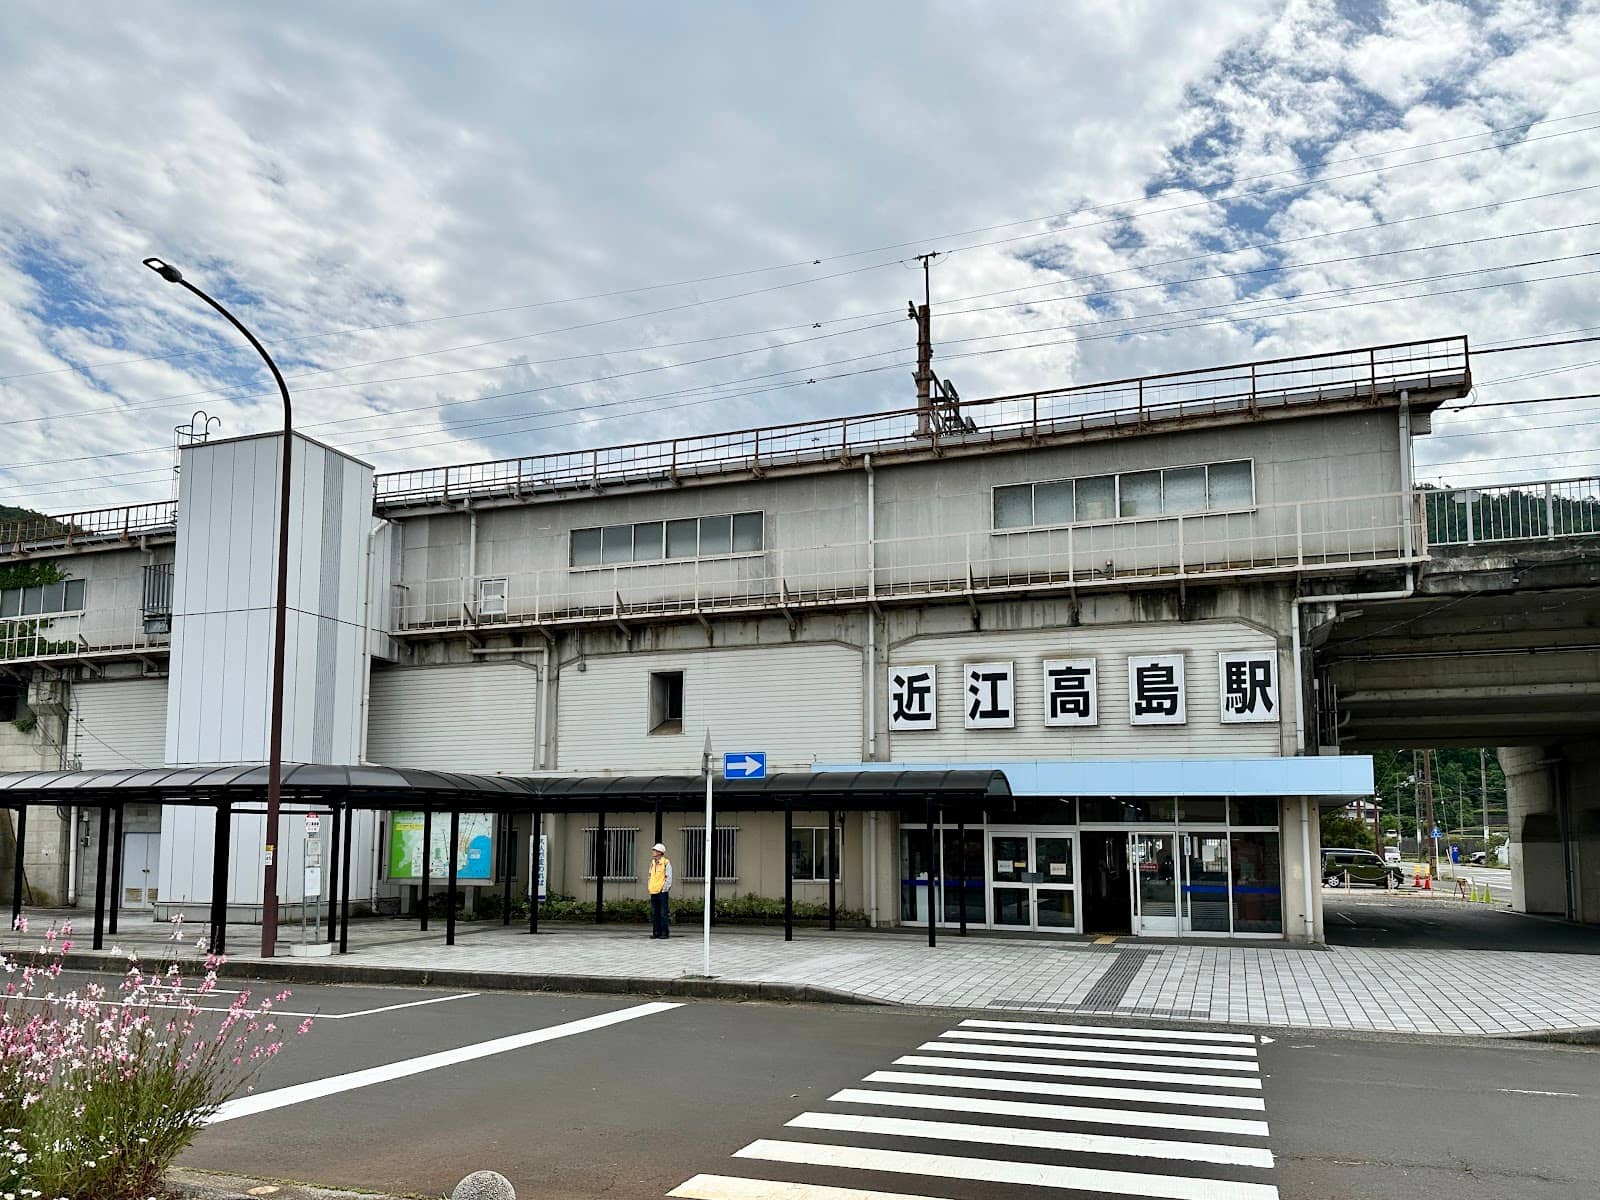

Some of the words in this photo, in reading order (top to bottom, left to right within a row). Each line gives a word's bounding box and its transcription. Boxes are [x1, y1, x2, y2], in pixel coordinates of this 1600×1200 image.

[893, 660, 1274, 722] 近江高島駅
